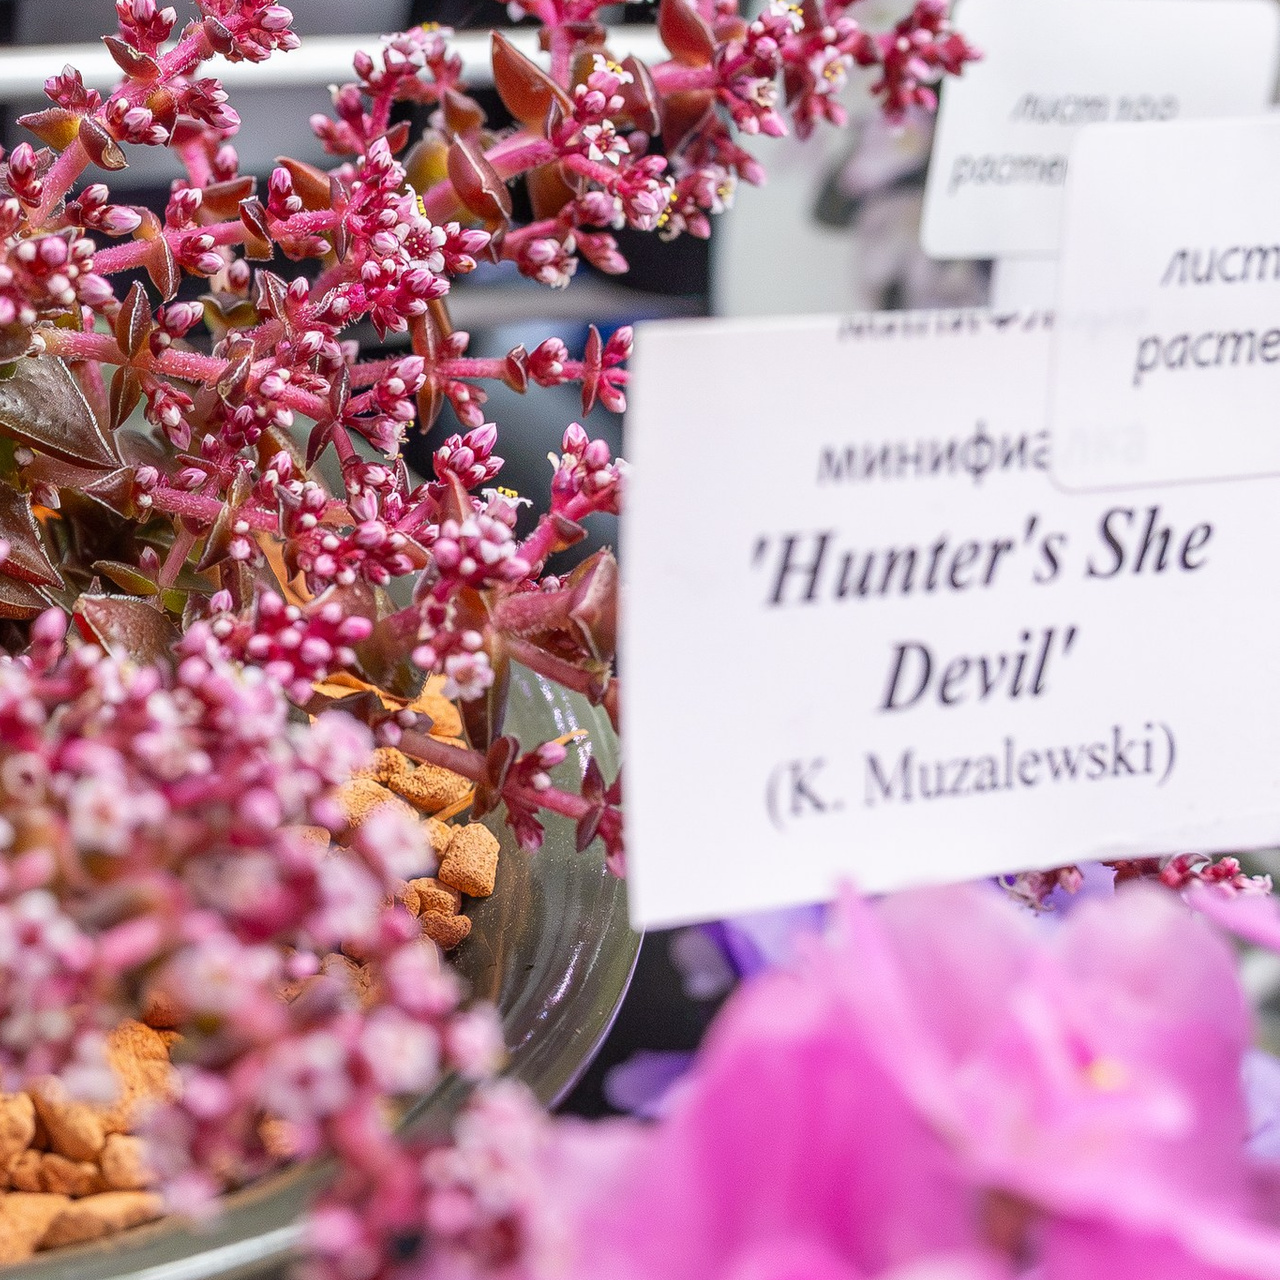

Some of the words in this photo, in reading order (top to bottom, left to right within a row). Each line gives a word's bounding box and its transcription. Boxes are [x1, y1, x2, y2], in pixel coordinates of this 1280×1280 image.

[949, 153, 1066, 198] расте
[1160, 244, 1280, 287] лист
[818, 420, 1052, 486] минифиа
[752, 516, 1069, 609] 'Hunter's
[1086, 506, 1215, 581] She
[879, 626, 1080, 714] Devil'
[764, 756, 846, 828] (K.
[864, 720, 1179, 808] Muzalewski)
